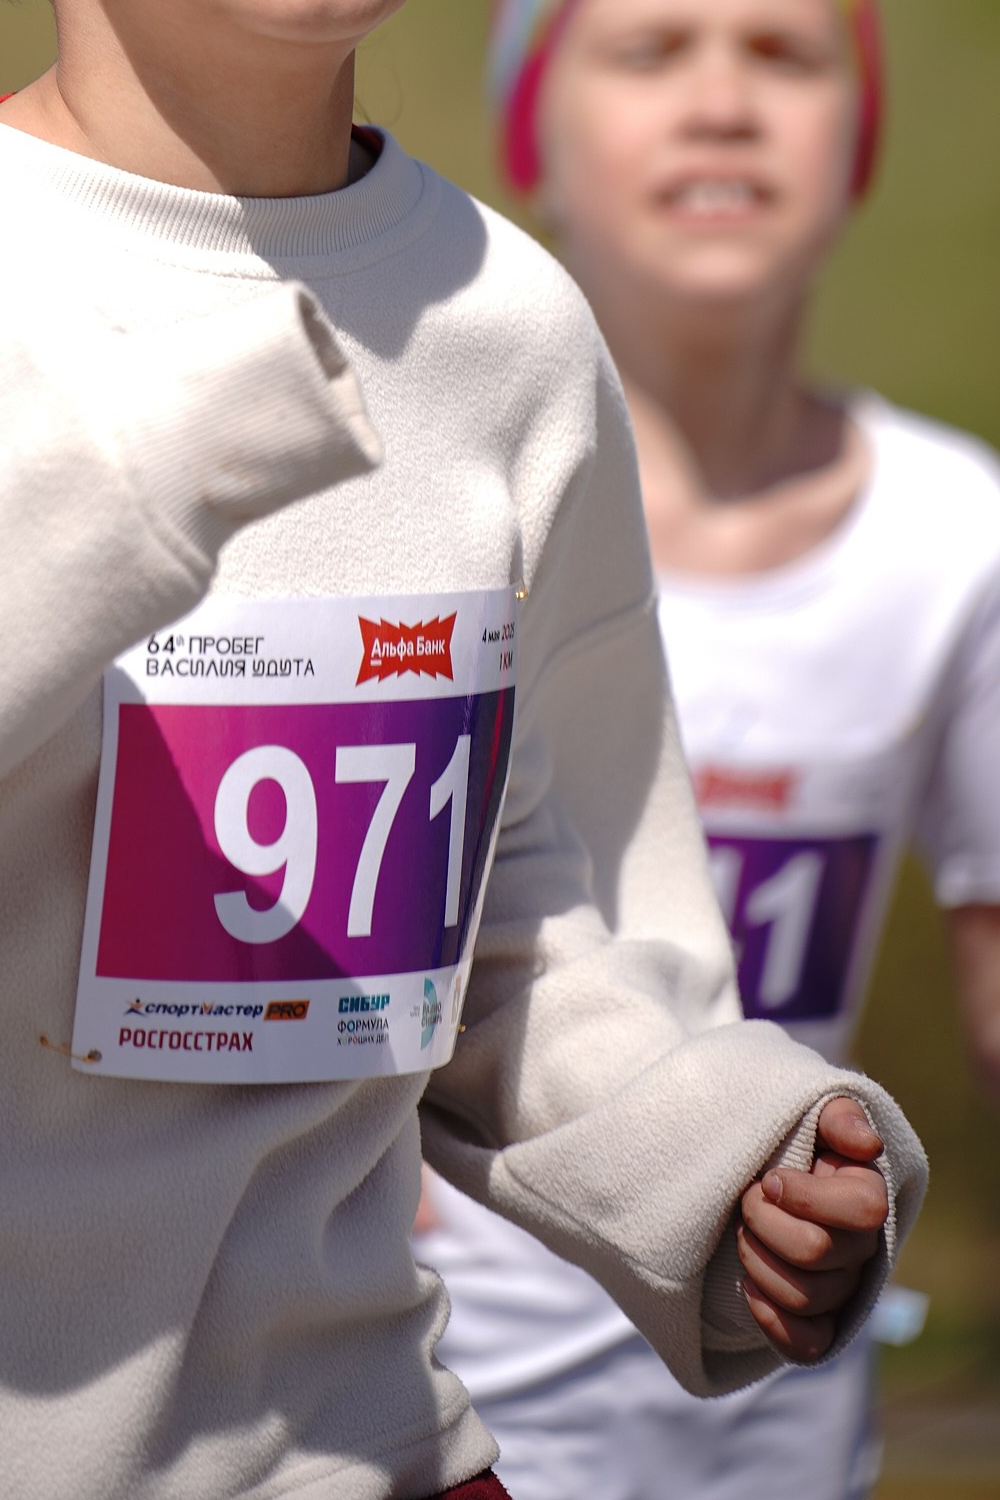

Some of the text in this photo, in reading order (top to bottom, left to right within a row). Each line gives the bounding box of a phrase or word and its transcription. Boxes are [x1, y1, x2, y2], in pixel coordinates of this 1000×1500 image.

[189, 636, 264, 655] ПРОБЕГ
[370, 635, 445, 665] Альфа Банк
[146, 658, 245, 677] ВАСИЛИЯ
[213, 735, 472, 945] 971
[266, 1001, 307, 1019] PRO
[338, 994, 390, 1013] СИБУР
[337, 1018, 389, 1033] ФОРМУЛА
[119, 1028, 253, 1051] РОСГОССТРАХ
